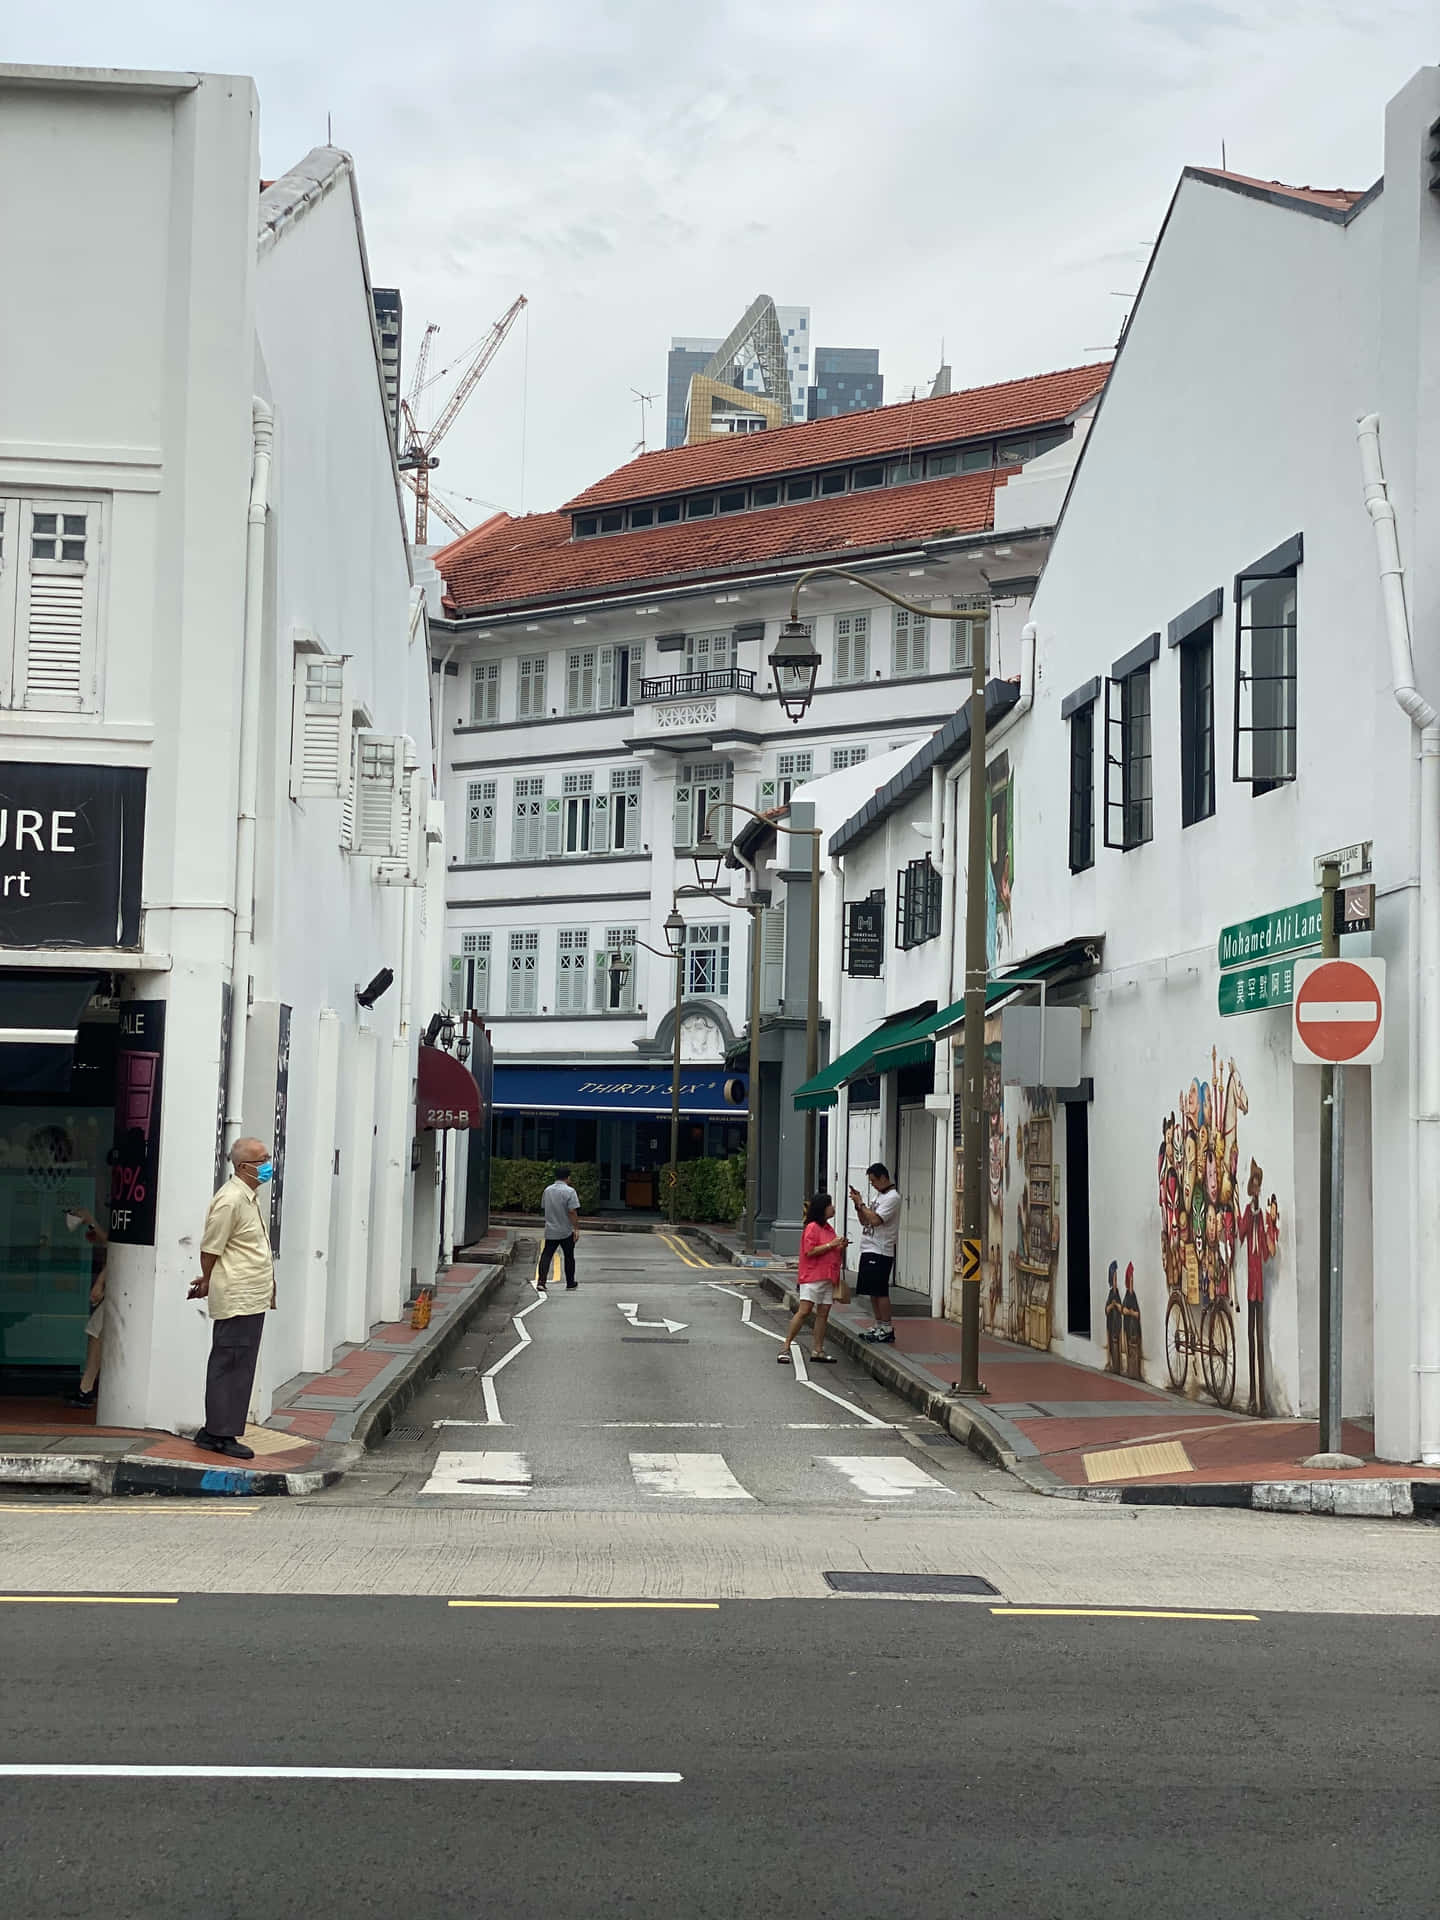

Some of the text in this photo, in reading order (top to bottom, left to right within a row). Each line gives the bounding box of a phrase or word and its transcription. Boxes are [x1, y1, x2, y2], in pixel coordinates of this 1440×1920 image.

[1223, 911, 1323, 961] Mohamed Ali Lane
[120, 1013, 145, 1034] ALE
[577, 1082, 664, 1095] THIRTY
[428, 1110, 469, 1121] 225-B
[112, 1209, 132, 1231] OFF
